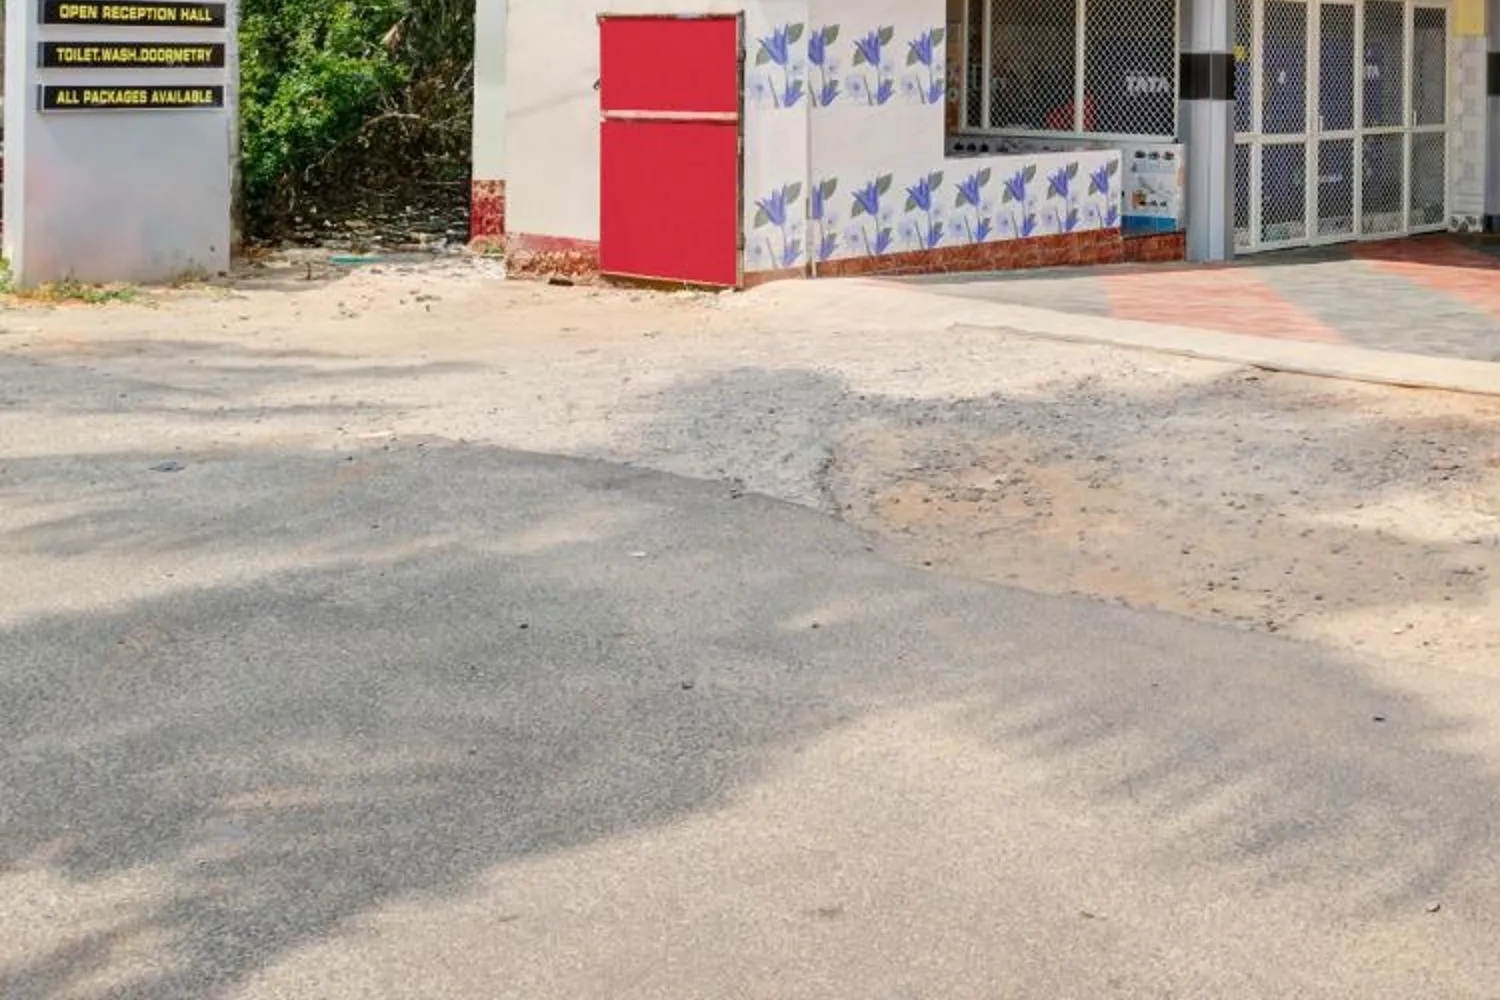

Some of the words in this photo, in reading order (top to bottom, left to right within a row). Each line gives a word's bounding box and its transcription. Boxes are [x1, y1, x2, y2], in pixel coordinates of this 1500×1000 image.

[60, 4, 97, 19] OPEN
[103, 6, 176, 21] RECEPTION
[181, 8, 212, 21] HALL
[56, 90, 79, 104] ALL
[84, 90, 147, 104] PACKAGES
[152, 90, 213, 104] AVAILABLE
